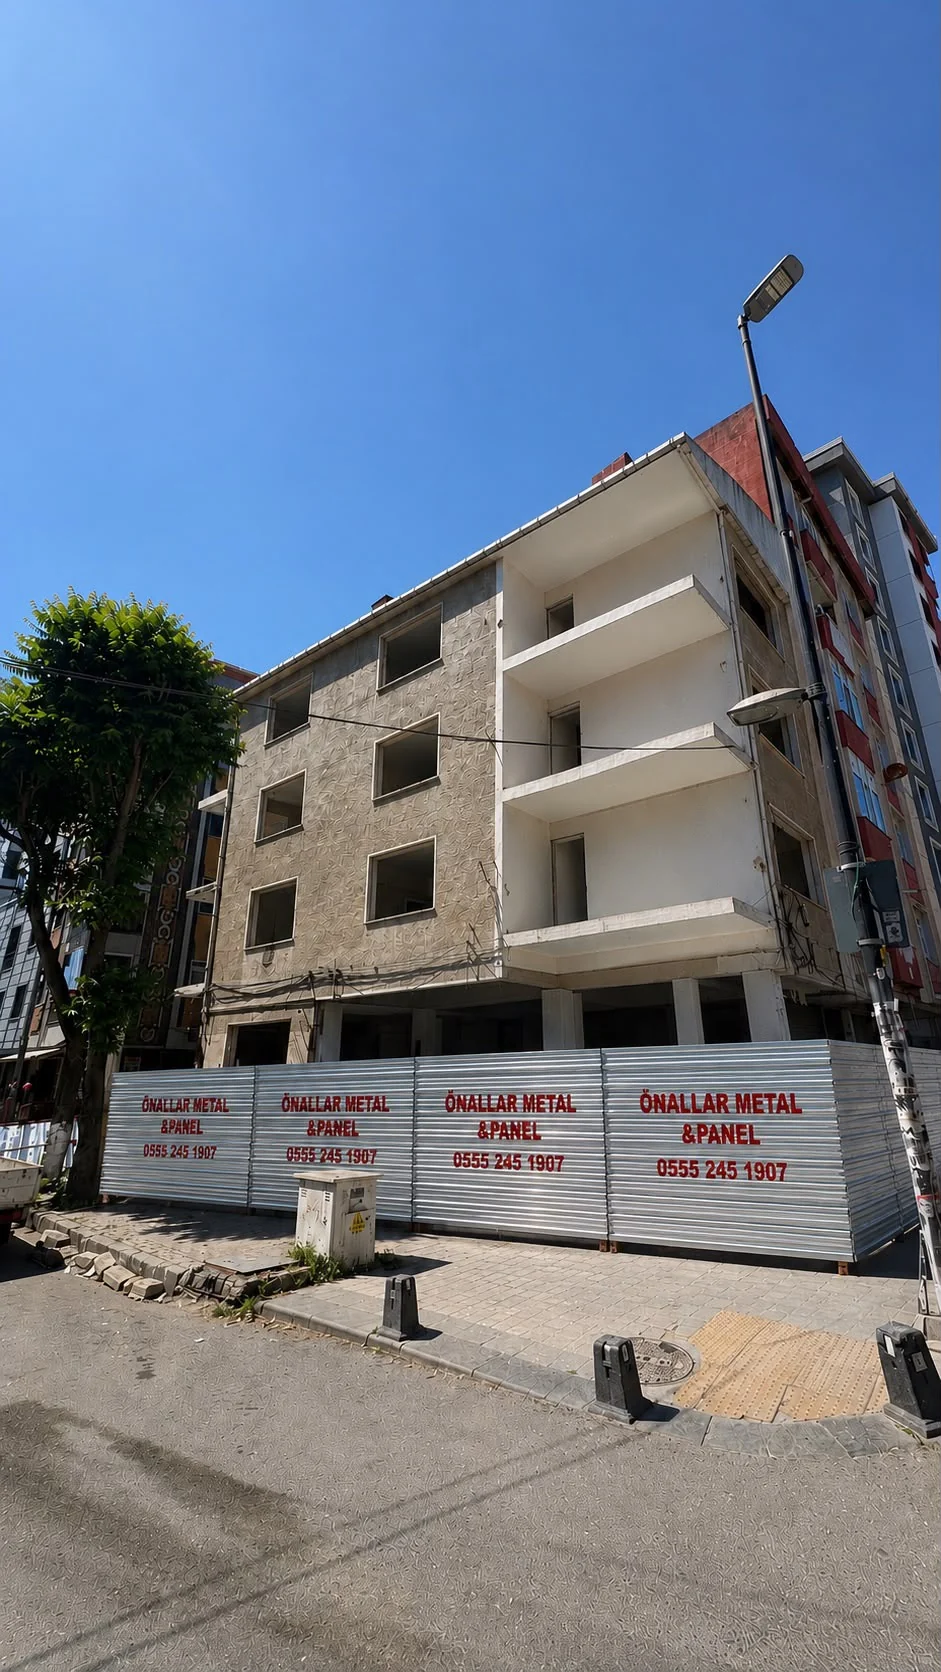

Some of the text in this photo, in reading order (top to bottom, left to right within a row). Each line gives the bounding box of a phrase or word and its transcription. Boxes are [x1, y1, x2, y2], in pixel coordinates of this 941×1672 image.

[142, 1095, 229, 1113] ÖNALLAR METAL
[281, 1093, 390, 1113] ÖNALLAR METAL
[445, 1090, 576, 1113] ÖNALLAR METAL
[640, 1089, 802, 1114] ÖNALLAR METAL
[161, 1119, 203, 1135] &PANEL
[307, 1120, 359, 1137] &PANEL
[478, 1121, 541, 1140] &PANEL
[682, 1123, 761, 1145] &PANEL
[143, 1143, 217, 1160] 0555 245 1907
[286, 1147, 377, 1164] 0555 245 1907
[453, 1152, 565, 1172] 0555 245 1907
[657, 1158, 787, 1181] 0555 245 1907
